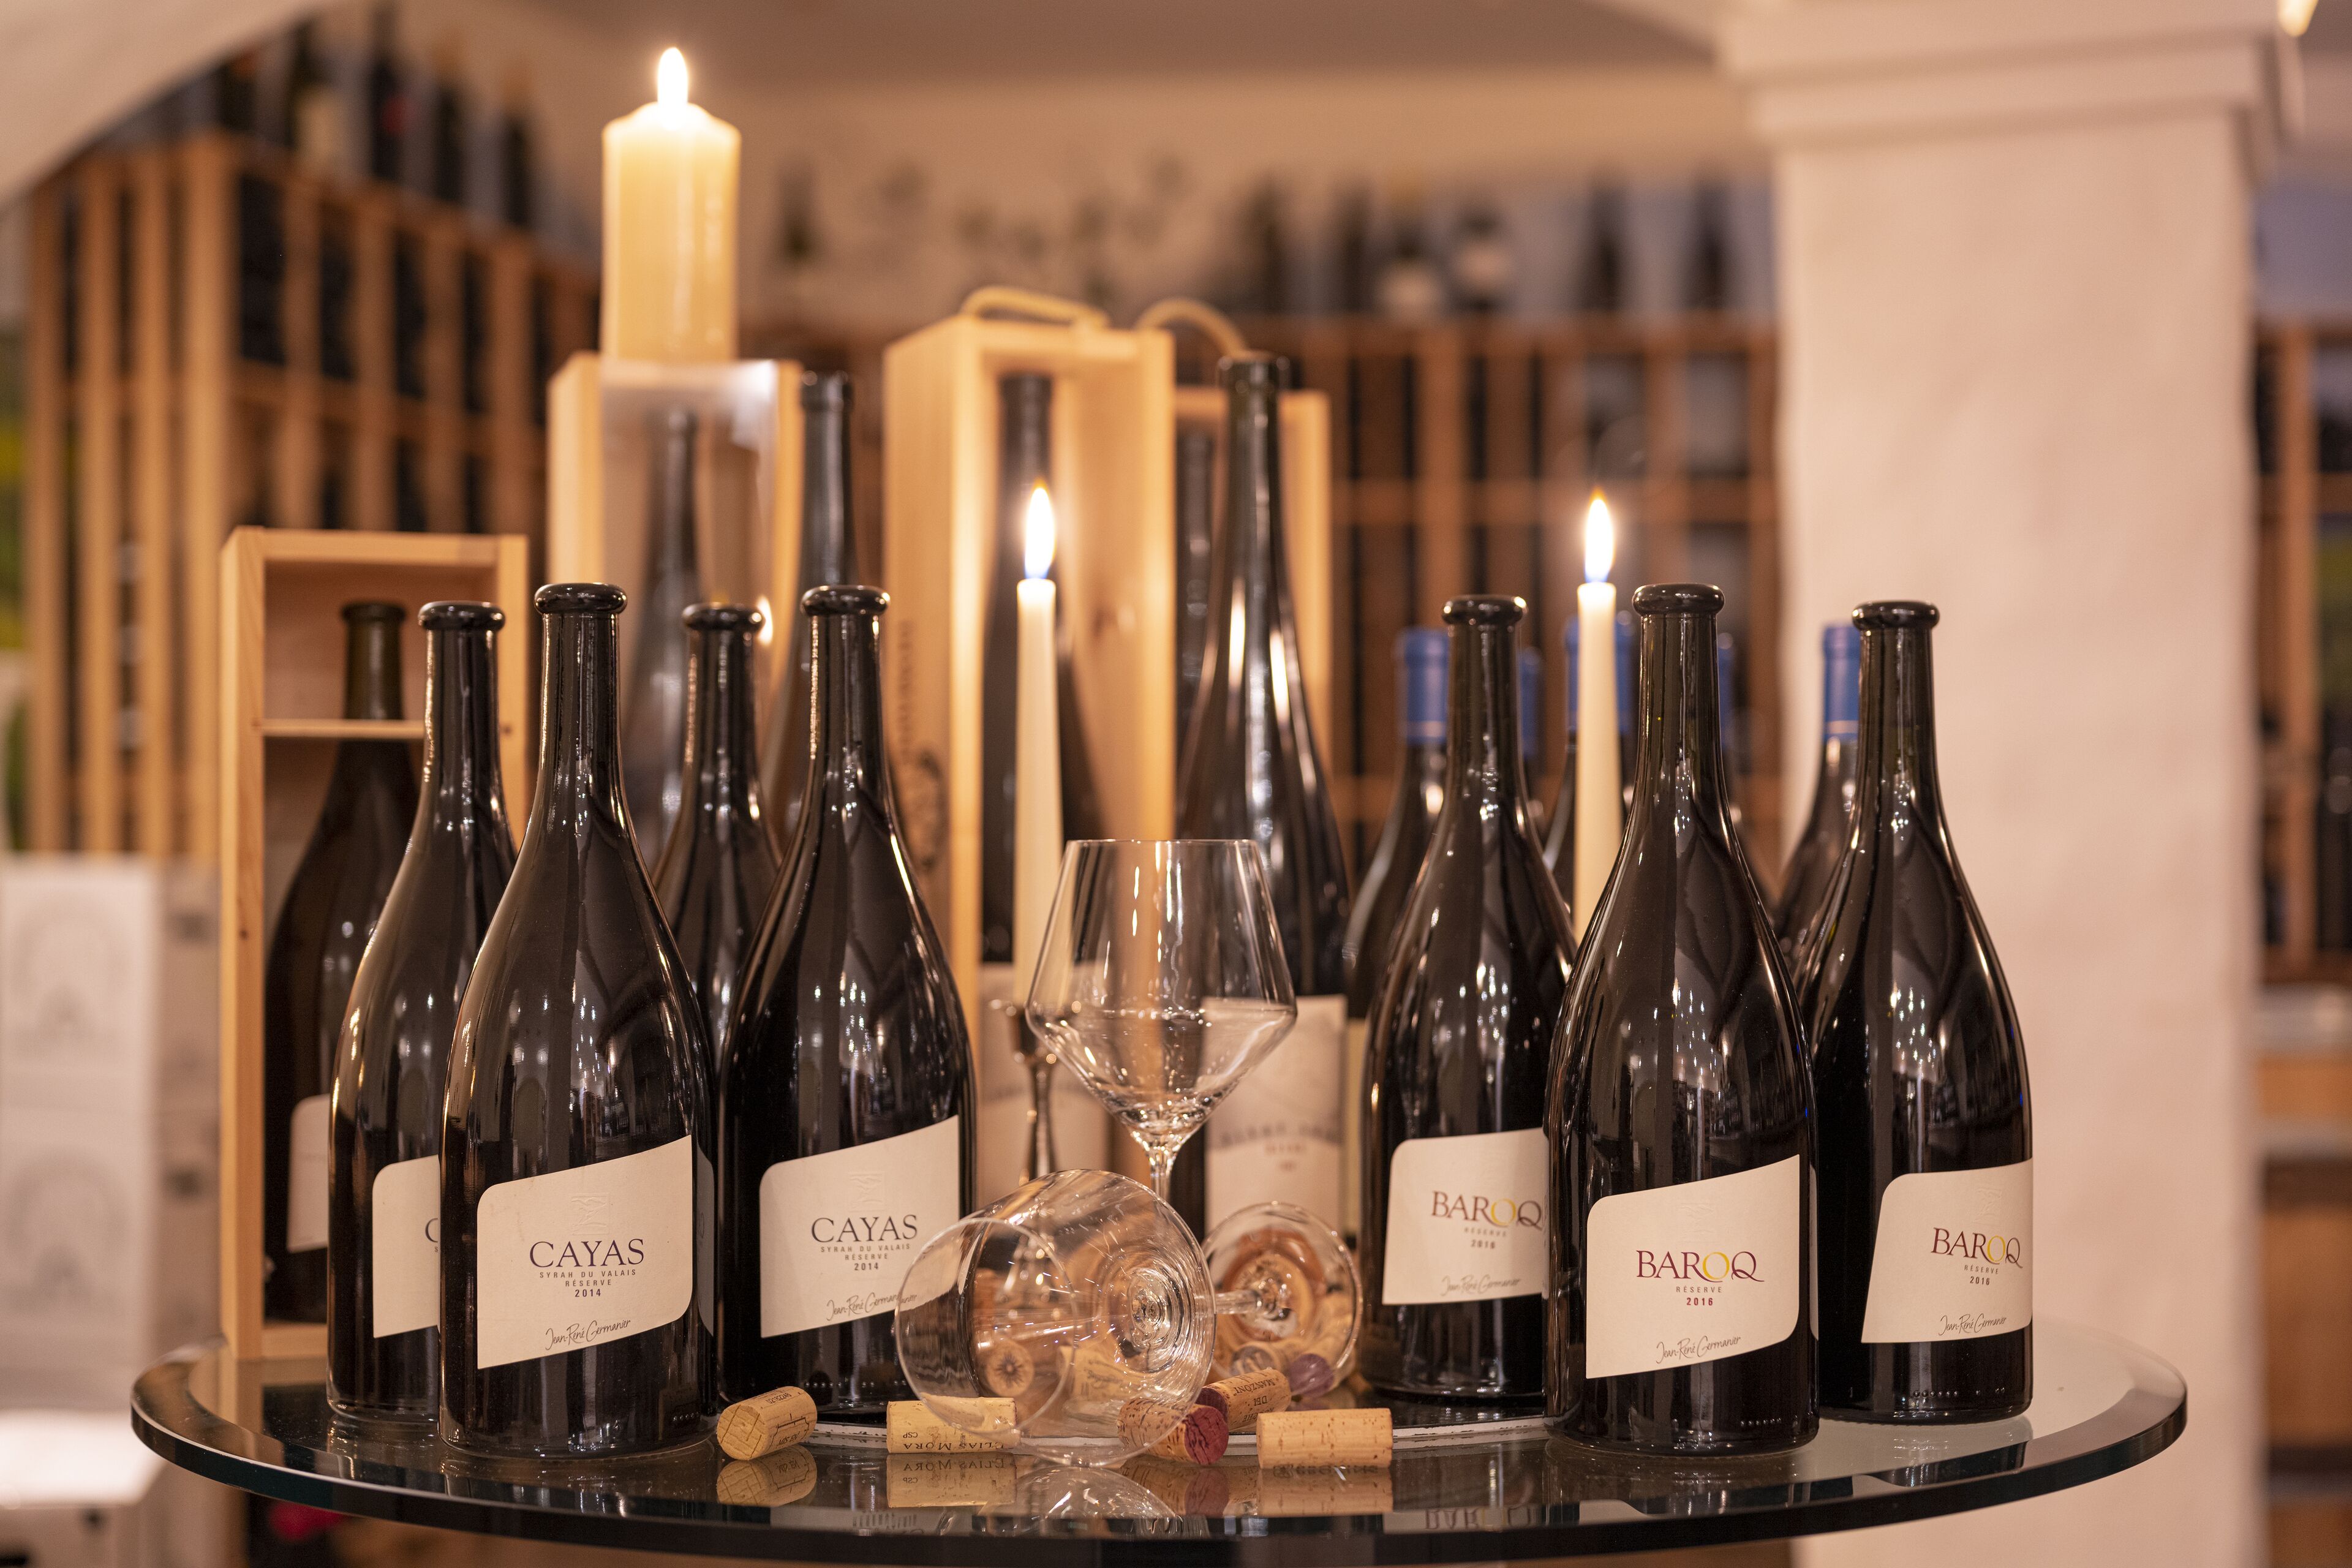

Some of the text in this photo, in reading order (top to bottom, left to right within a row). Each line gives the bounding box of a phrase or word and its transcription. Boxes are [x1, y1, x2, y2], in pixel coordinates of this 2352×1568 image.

[1431, 1191, 1542, 1231] BAROQ
[812, 1215, 918, 1242] CAYAS
[530, 1238, 644, 1267] CAYAS
[1931, 1227, 2023, 1268] BAROQ
[1636, 1251, 1764, 1282] BAROQ
[1964, 1265, 1999, 1275] RÉSERVE
[1970, 1276, 1990, 1285] 2016
[575, 1289, 601, 1298] 2014
[1687, 1297, 1713, 1306] 2016
[1254, 1395, 1268, 1406] DEI
[903, 1442, 952, 1451] MORA
